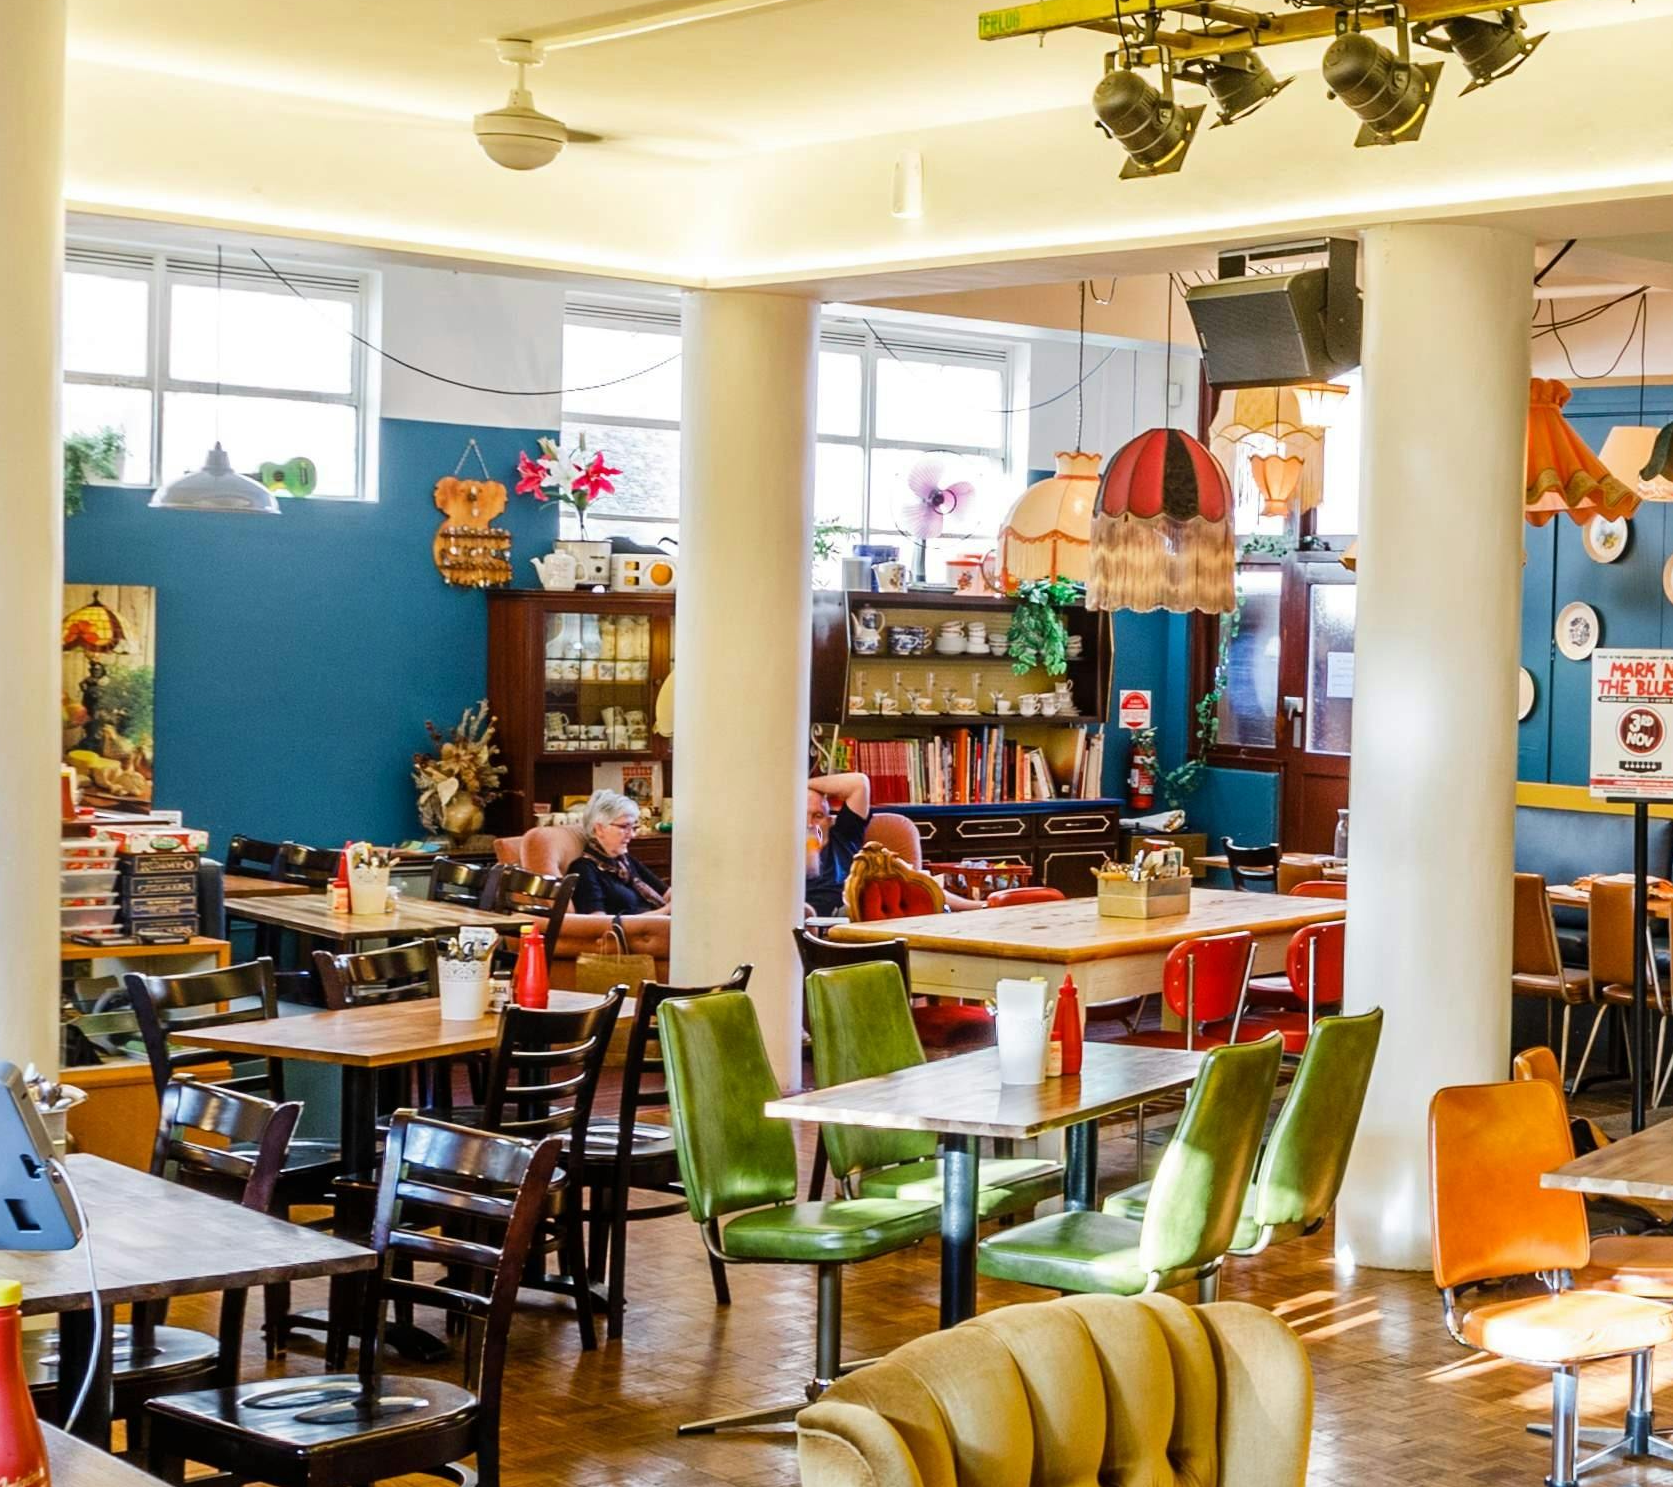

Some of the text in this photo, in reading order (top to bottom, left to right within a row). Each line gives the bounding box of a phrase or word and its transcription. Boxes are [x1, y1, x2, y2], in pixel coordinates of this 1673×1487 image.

[1610, 662, 1655, 678] MARK
[1598, 679, 1632, 696] THE
[1627, 733, 1655, 748] NOV
